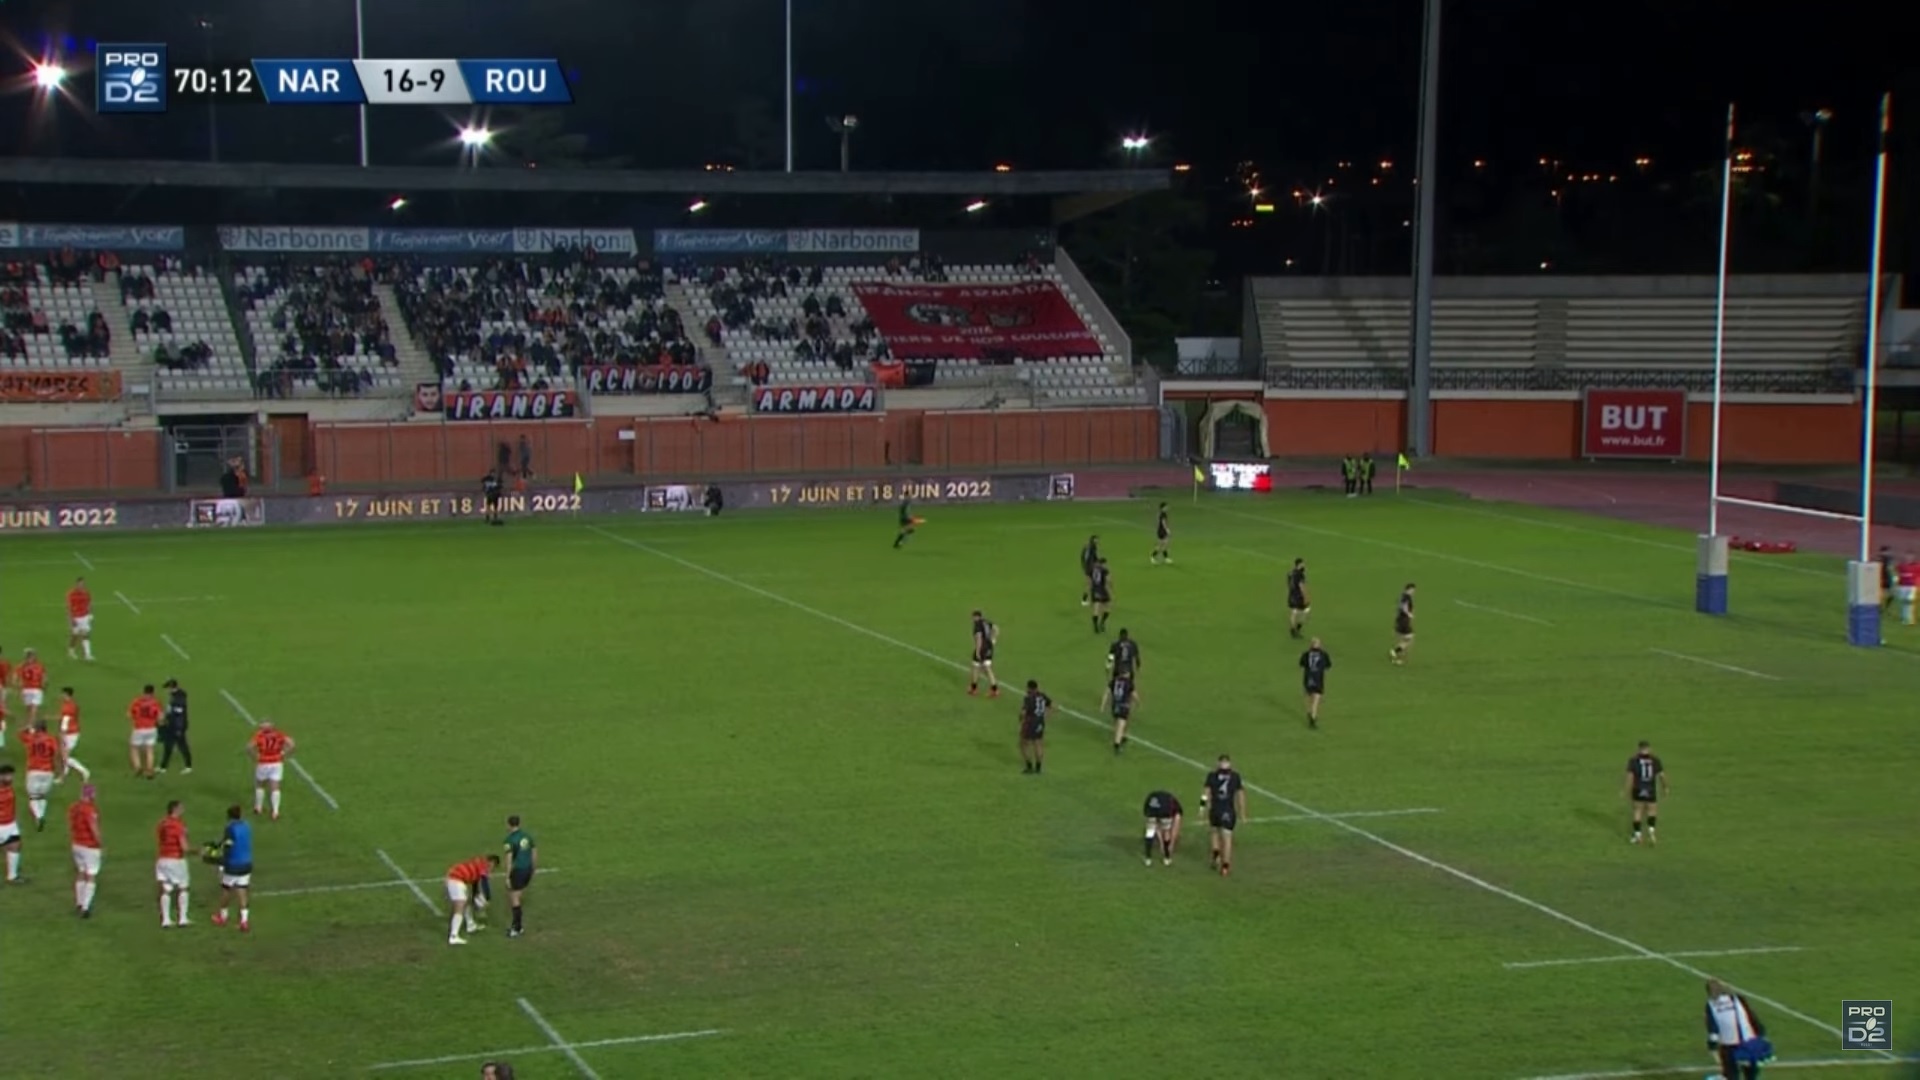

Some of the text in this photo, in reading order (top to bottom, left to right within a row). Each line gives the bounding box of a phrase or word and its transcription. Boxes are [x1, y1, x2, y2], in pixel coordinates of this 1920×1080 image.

[245, 227, 364, 249] Narbonne
[811, 229, 914, 250] Narbonne
[589, 368, 637, 392] RCN
[455, 393, 566, 419] IRANGE
[759, 388, 874, 411] ARMADA
[1601, 405, 1668, 430] BUT
[1601, 435, 1666, 447] www.but.fr
[769, 485, 792, 503] 17
[798, 486, 840, 502] JUIN
[846, 485, 865, 501] ET
[872, 484, 893, 500] 18
[946, 481, 991, 498] 2022
[335, 499, 358, 518] 17
[366, 499, 412, 517] JUIN
[421, 499, 441, 515] ET
[450, 497, 473, 514] 18
[532, 494, 582, 511] 2022
[58, 508, 117, 527] 2022
